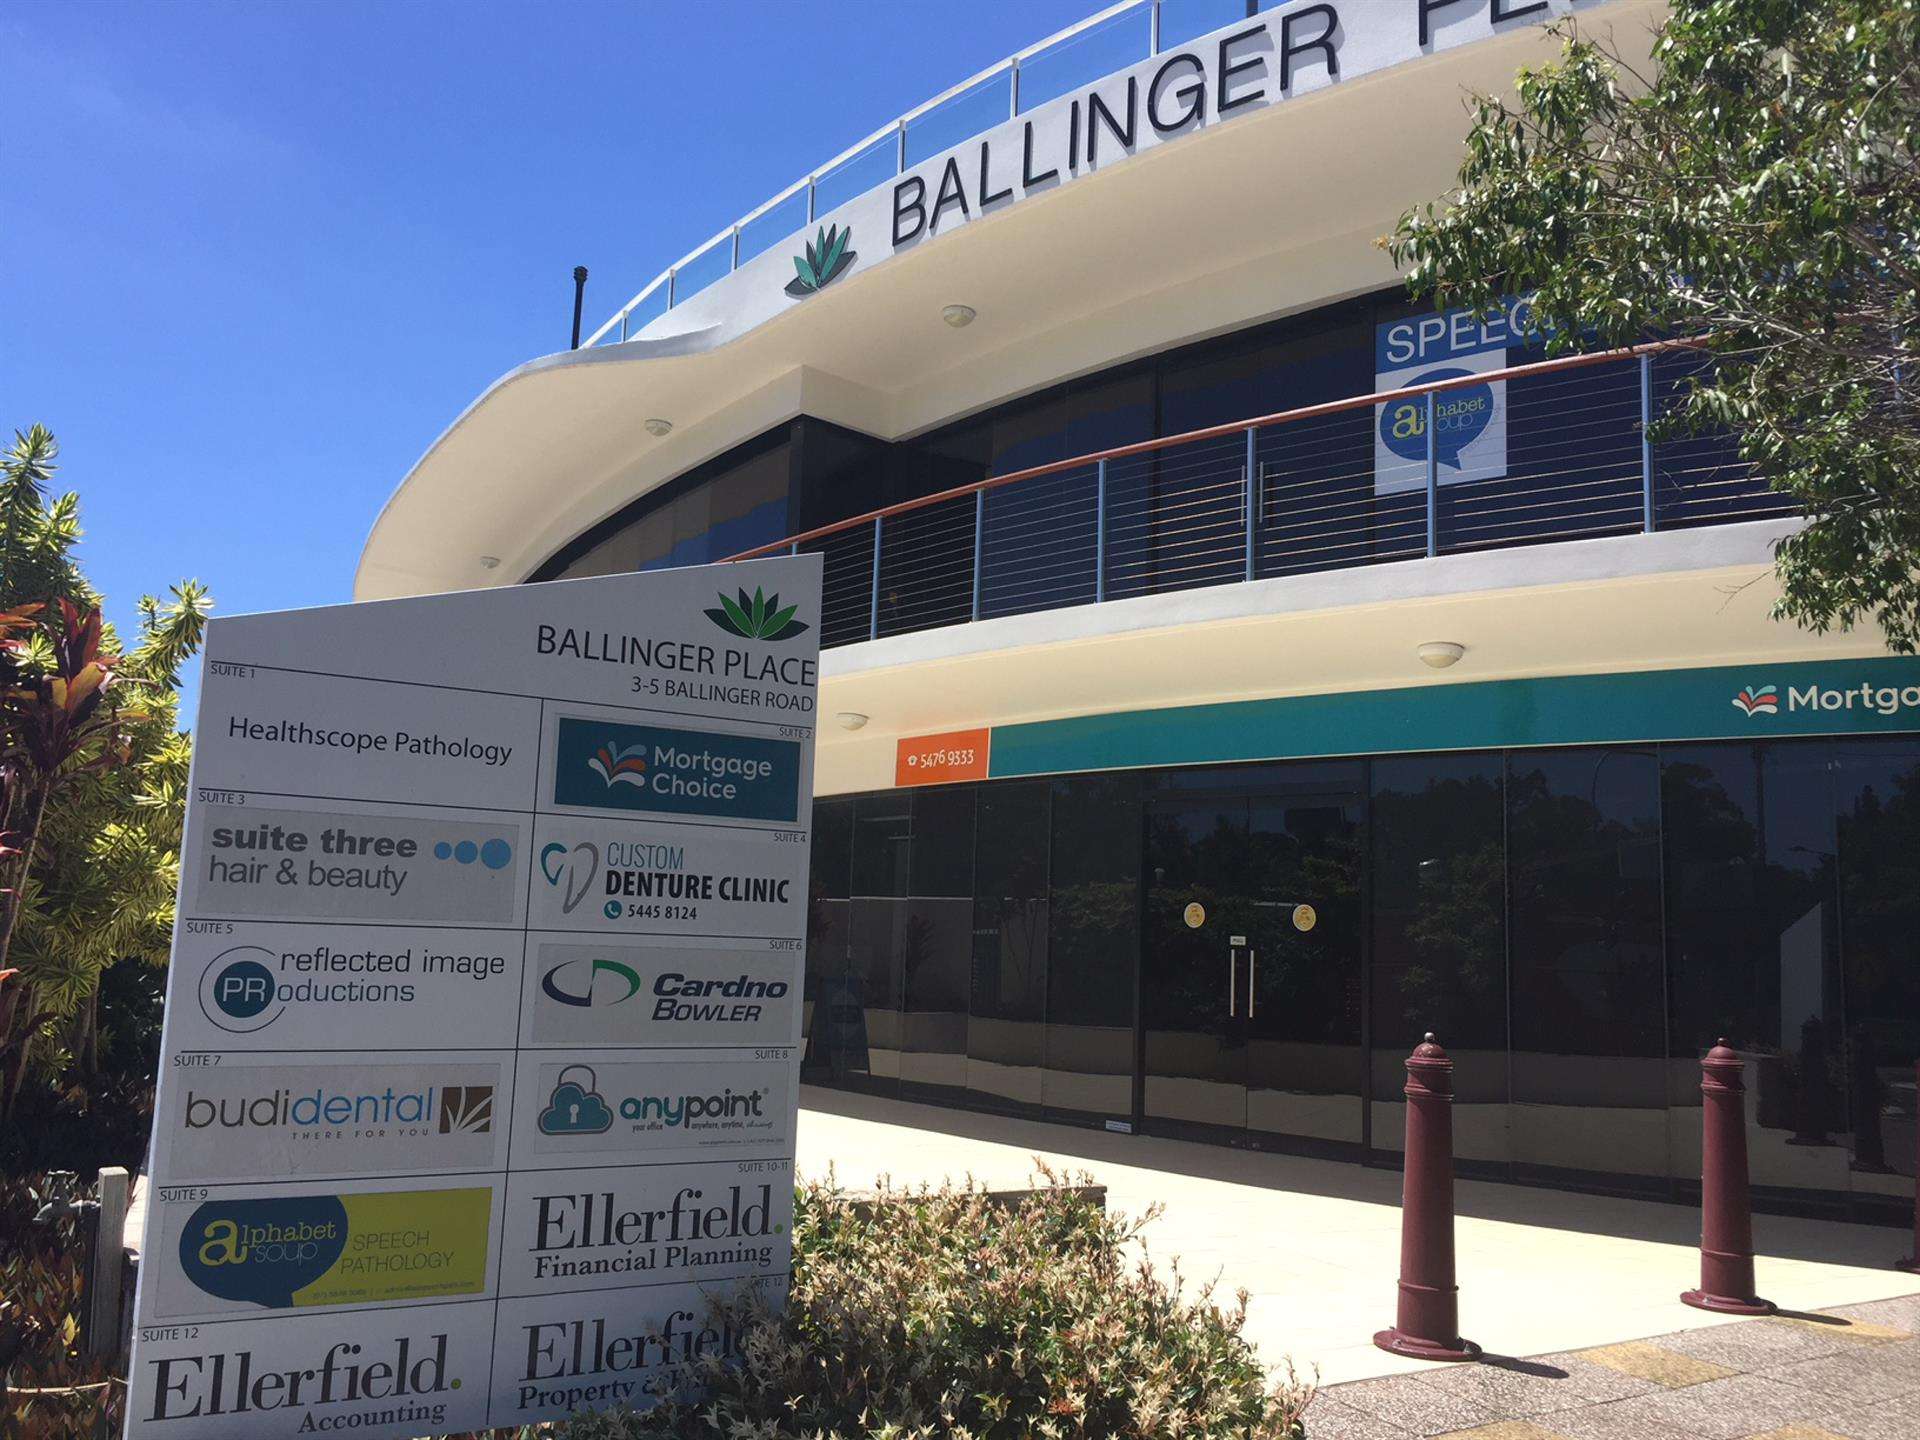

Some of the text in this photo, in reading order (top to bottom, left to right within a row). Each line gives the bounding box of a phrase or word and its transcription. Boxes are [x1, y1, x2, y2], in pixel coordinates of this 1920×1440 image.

[891, 3, 1338, 247] BALLINGER
[537, 624, 816, 687] BALLINGER PLACE
[211, 663, 256, 678] SUITE 1
[632, 676, 814, 712] 3-5 BALLINGER ROAD
[229, 717, 513, 766] Healthscope Pathology
[779, 726, 812, 738] SUITE 2
[654, 746, 773, 780] Mortgage
[920, 749, 974, 768] 5476 9333
[199, 791, 246, 805] SUITE 3
[652, 773, 738, 800] Choice
[212, 824, 418, 858] suite three
[774, 832, 806, 843] SUITE 4
[607, 841, 684, 870] CUSTOM
[209, 856, 408, 896] hair & beauty
[605, 869, 790, 904] DENTURE CLINIC
[628, 904, 697, 920] 5445 8124
[186, 921, 234, 935] SUITE 5
[769, 939, 802, 950] SUITE 6
[280, 946, 505, 980] reflected image
[653, 972, 789, 999] Cardno
[652, 998, 762, 1022] BOWLER
[173, 1055, 222, 1068] SUITE 7
[755, 1049, 788, 1060] SUITE 8
[184, 1085, 434, 1130] budidental
[619, 1087, 763, 1129] anypoint
[292, 1128, 429, 1141] THERE FOR YOU
[738, 1163, 764, 1173] SUITE
[159, 1188, 208, 1203] SUITE 9
[199, 1219, 338, 1267] alphabet
[254, 1241, 319, 1264] soup
[352, 1230, 430, 1252] SPEECH
[340, 1252, 455, 1275] PATHOLOGY
[534, 1243, 772, 1279] Financial Planning
[141, 1328, 199, 1343] SUITE 12
[297, 1400, 447, 1434] Accounting
